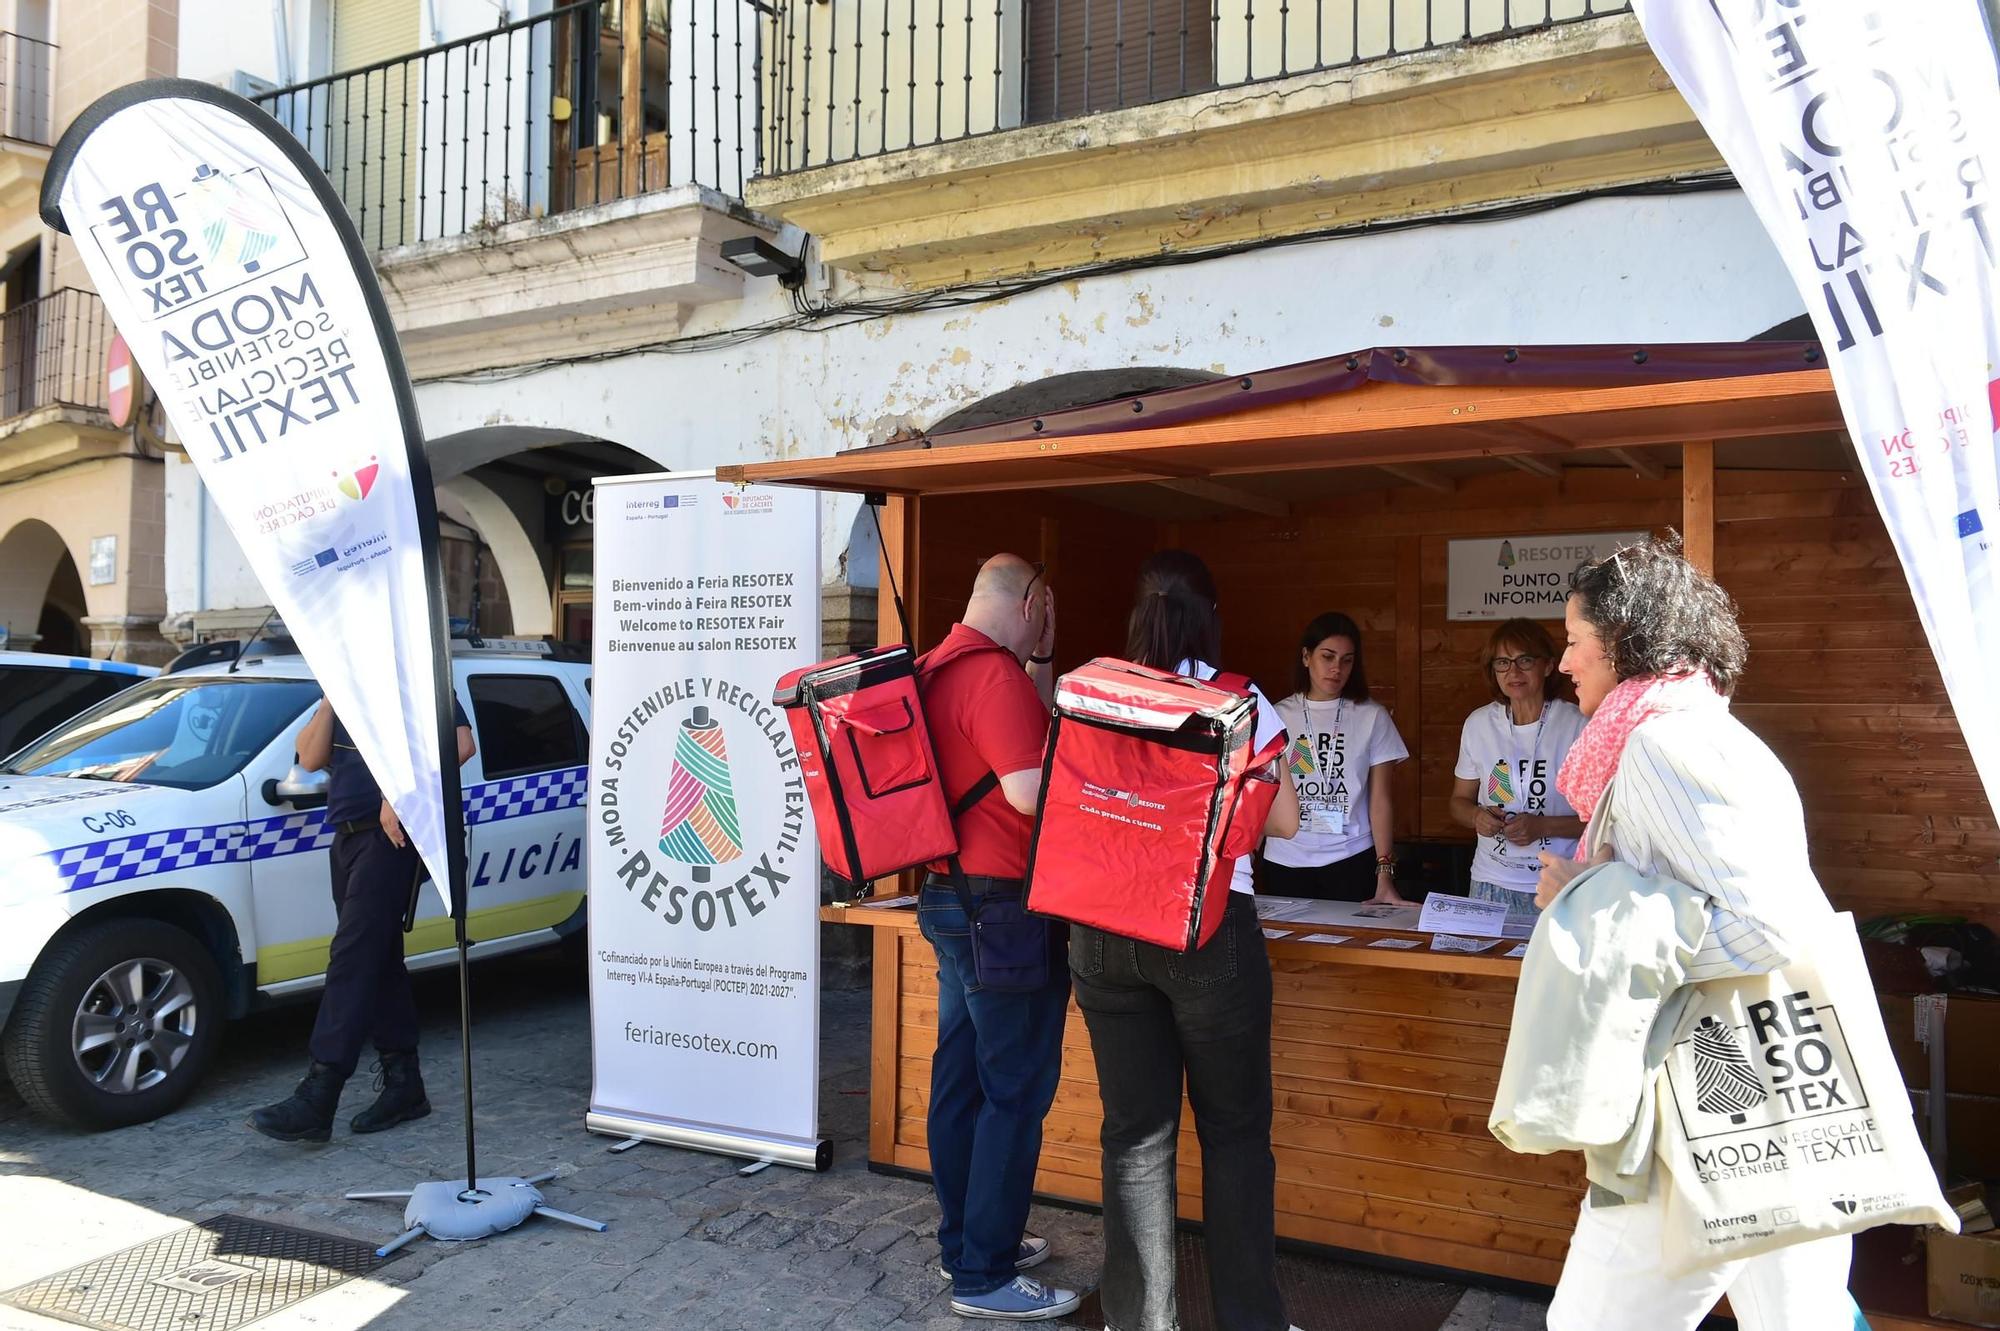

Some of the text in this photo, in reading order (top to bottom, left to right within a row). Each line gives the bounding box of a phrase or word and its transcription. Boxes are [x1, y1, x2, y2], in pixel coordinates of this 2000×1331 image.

[1518, 545, 1595, 561] RESOTEX
[612, 573, 794, 592] Bienvenido a Feria RESOTEX
[1503, 573, 1560, 587] PUNTO
[613, 594, 792, 612] Bem-vindo à Feira RESOTEX
[620, 615, 785, 632] Welcome to RESOTEX Fair
[484, 640, 547, 651] USTER
[608, 637, 797, 652] Bienvenue au salon RESOTEX
[1318, 733, 1344, 750] RE
[601, 677, 804, 853] MODA SOSTENIBLE Y RECICLAJE TEXTIL
[1139, 800, 1166, 810] RESOTEX
[1528, 797, 1546, 809] EX
[82, 809, 136, 833] C-06
[1080, 804, 1162, 831] Cada prenda cuenta
[472, 832, 581, 887] LICÍA
[617, 849, 791, 932] RESOTEX
[650, 957, 661, 968] por
[663, 955, 669, 967] la
[671, 957, 692, 969] Unión
[694, 959, 723, 974] Europea
[725, 966, 729, 974] a
[731, 963, 753, 976] través
[756, 965, 767, 977] del
[770, 967, 807, 982] Programa
[607, 969, 636, 985] Interreg
[638, 971, 653, 984] VI-A
[655, 973, 711, 993] España-Portugal
[713, 979, 748, 995] (POCTEP)
[1747, 990, 1823, 1045] RE
[625, 1022, 778, 1060] feriaresotex.com
[1764, 1038, 1833, 1083] SO
[1775, 1078, 1847, 1114] TEX
[1692, 1139, 1786, 1172] MODA
[1792, 1118, 1876, 1143] RECICLAJE
[1699, 1133, 1884, 1184] SOSTENIBLE TEXTIL
[1704, 1213, 1758, 1230] Interreg
[1743, 1229, 1775, 1239] Portugal
